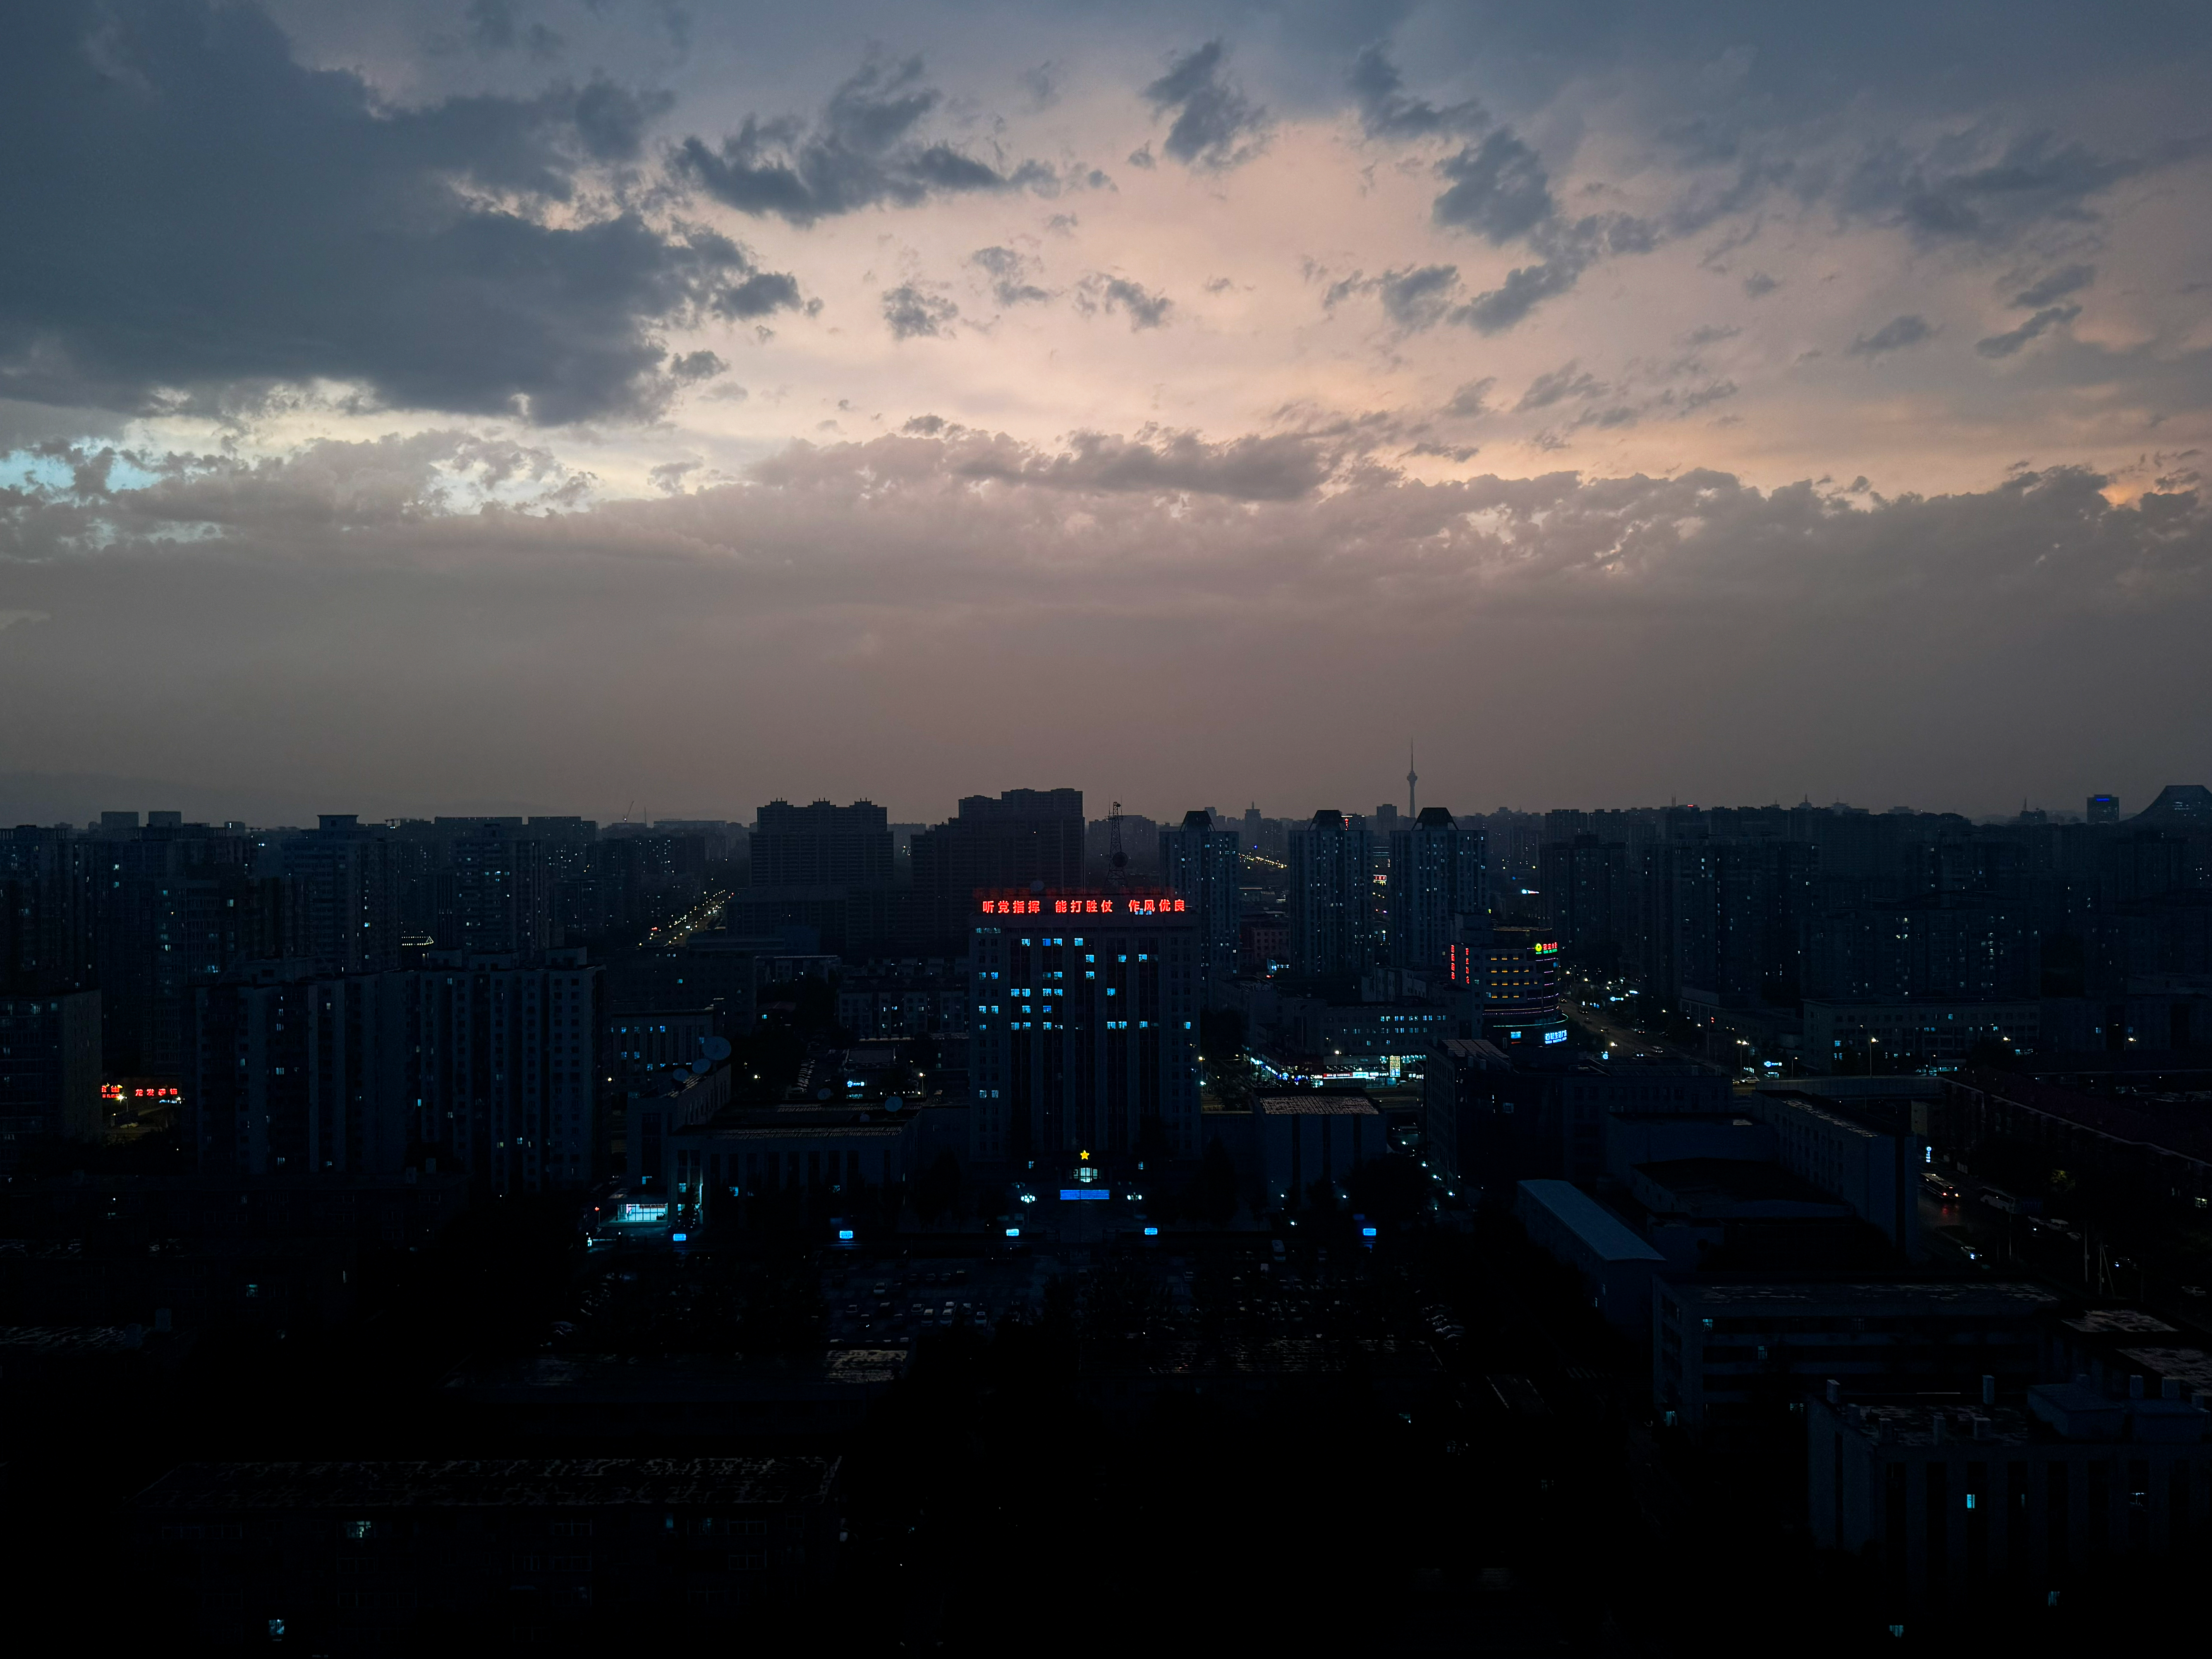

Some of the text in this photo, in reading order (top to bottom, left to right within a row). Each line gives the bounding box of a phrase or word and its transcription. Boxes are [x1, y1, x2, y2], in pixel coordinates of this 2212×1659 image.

[982, 899, 1185, 914] 听党指挥 能打胜仗 作风优良
